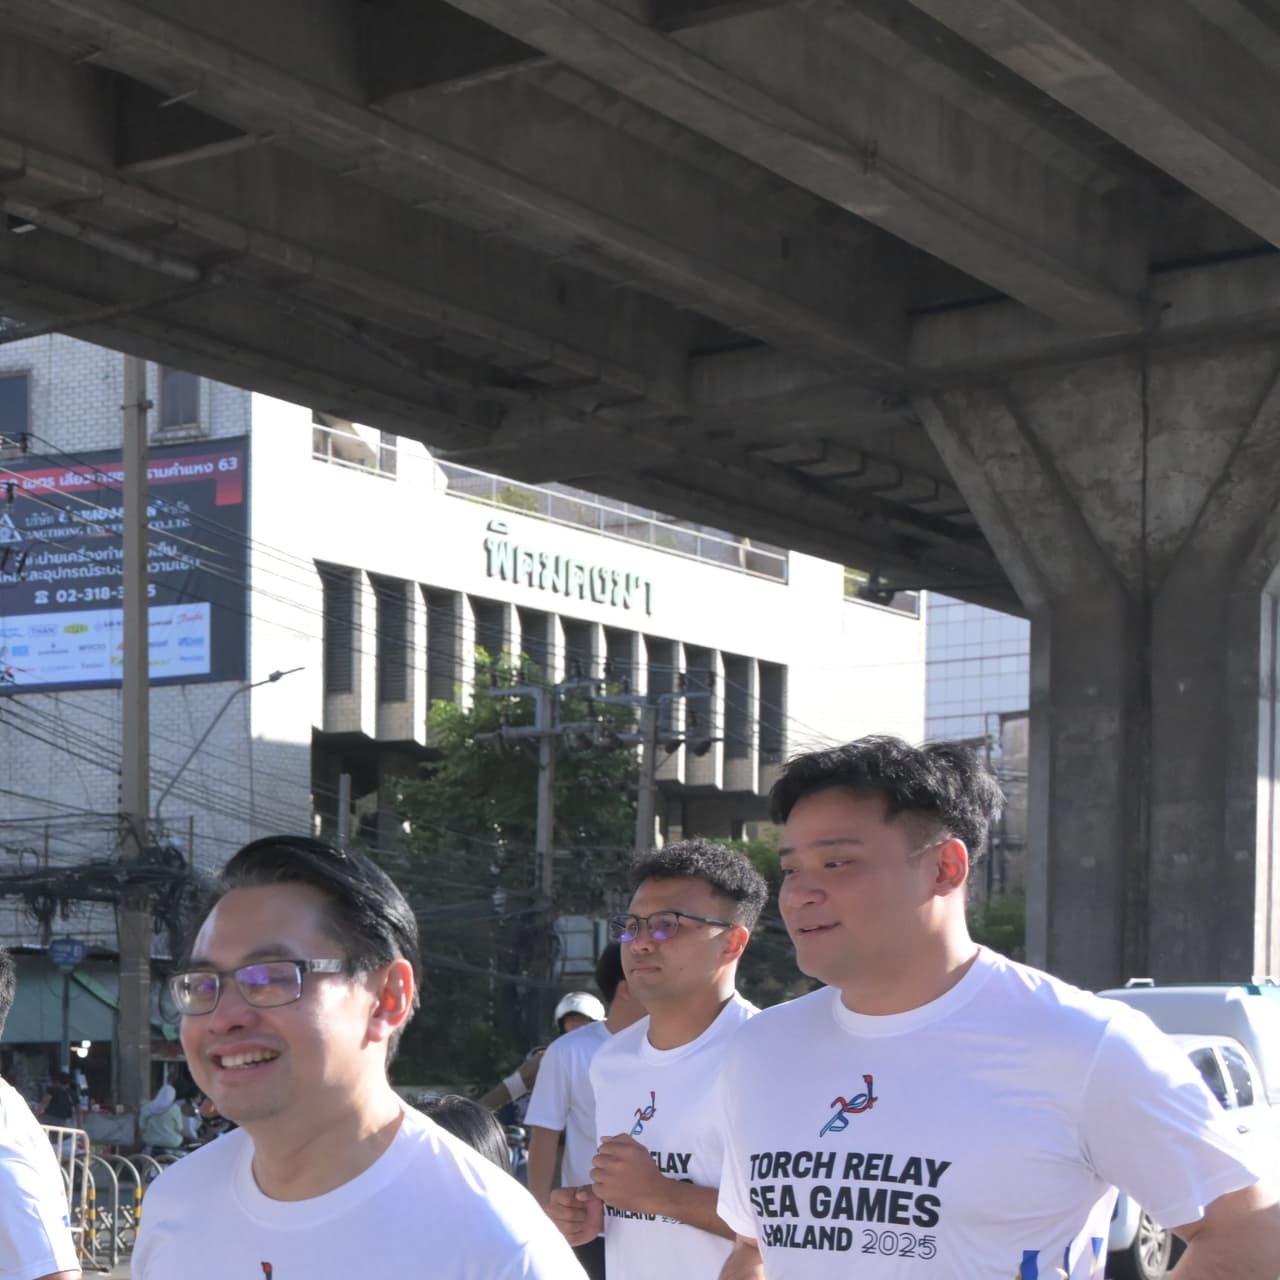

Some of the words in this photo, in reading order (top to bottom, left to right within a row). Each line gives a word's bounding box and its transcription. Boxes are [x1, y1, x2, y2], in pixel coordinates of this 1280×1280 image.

[218, 456, 239, 473] 63
[750, 1151, 837, 1181] TORCH
[843, 1152, 953, 1188] RELAY
[749, 1184, 800, 1218] SEA
[809, 1185, 942, 1228] GAMES
[860, 1227, 937, 1260] 2025
